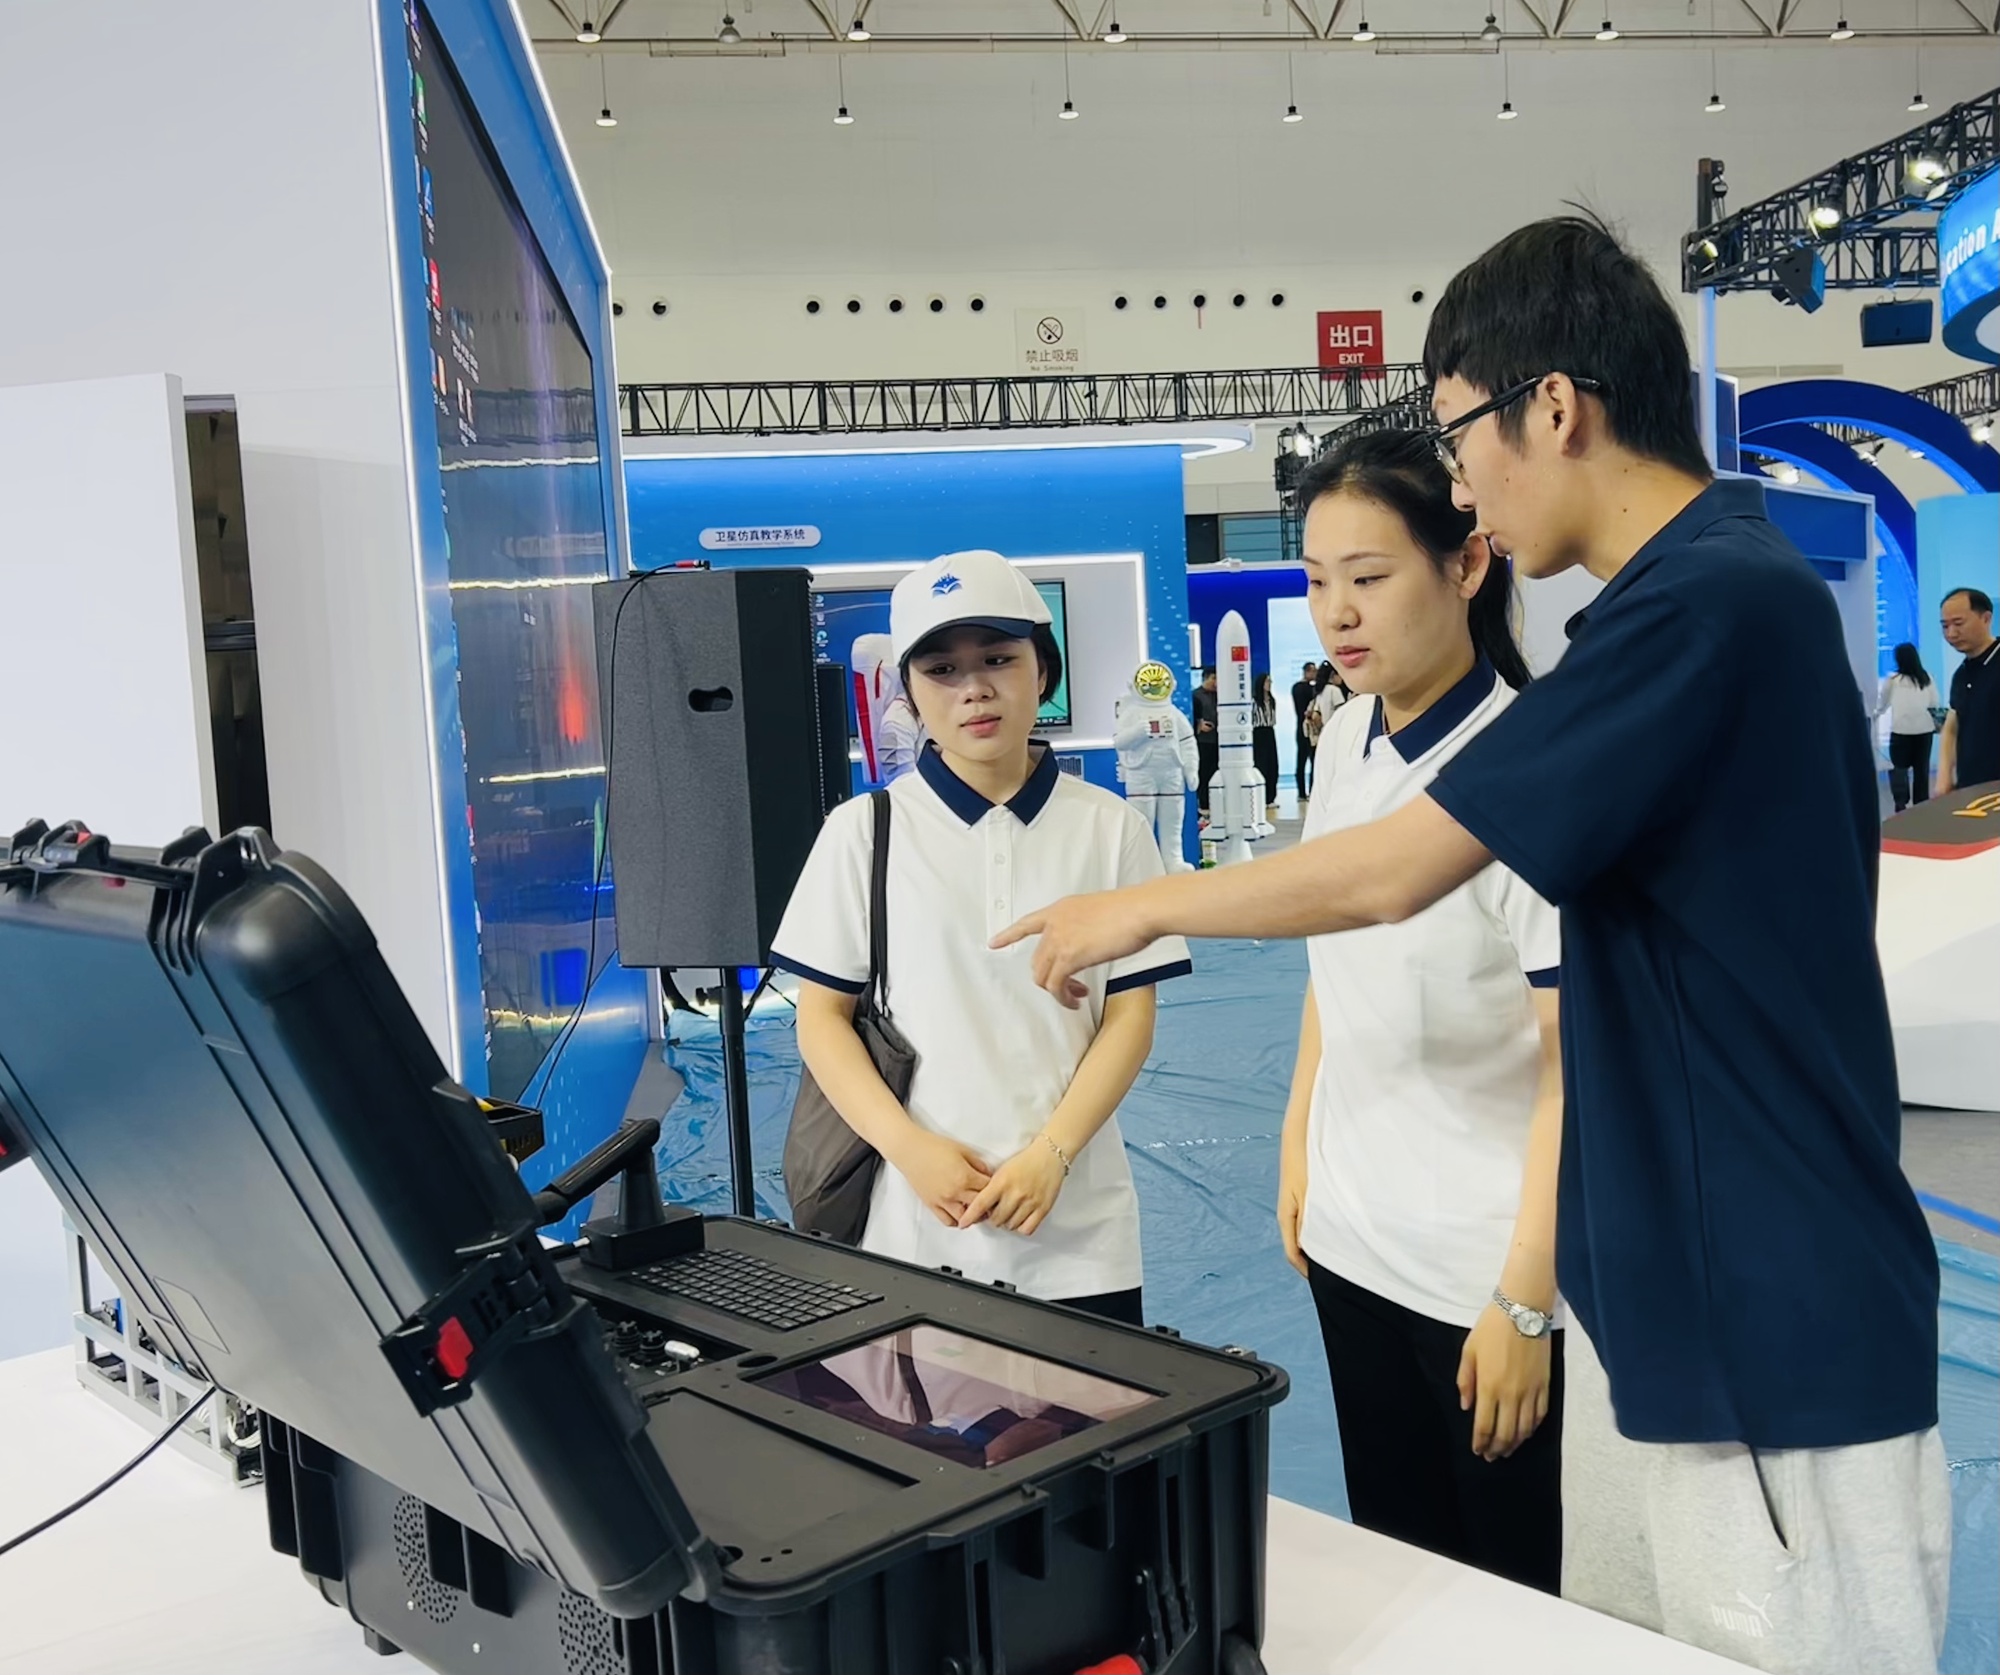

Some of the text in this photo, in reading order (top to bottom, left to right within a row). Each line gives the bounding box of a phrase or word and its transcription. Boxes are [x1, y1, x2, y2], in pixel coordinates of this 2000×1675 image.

[1945, 224, 1987, 276] cation
[1329, 324, 1373, 348] 出口
[1026, 348, 1079, 363] 禁止吸烟
[1338, 352, 1365, 365] EXIT
[715, 528, 806, 543] 卫星仿真教学系统
[1710, 1603, 1764, 1639] PUMA
